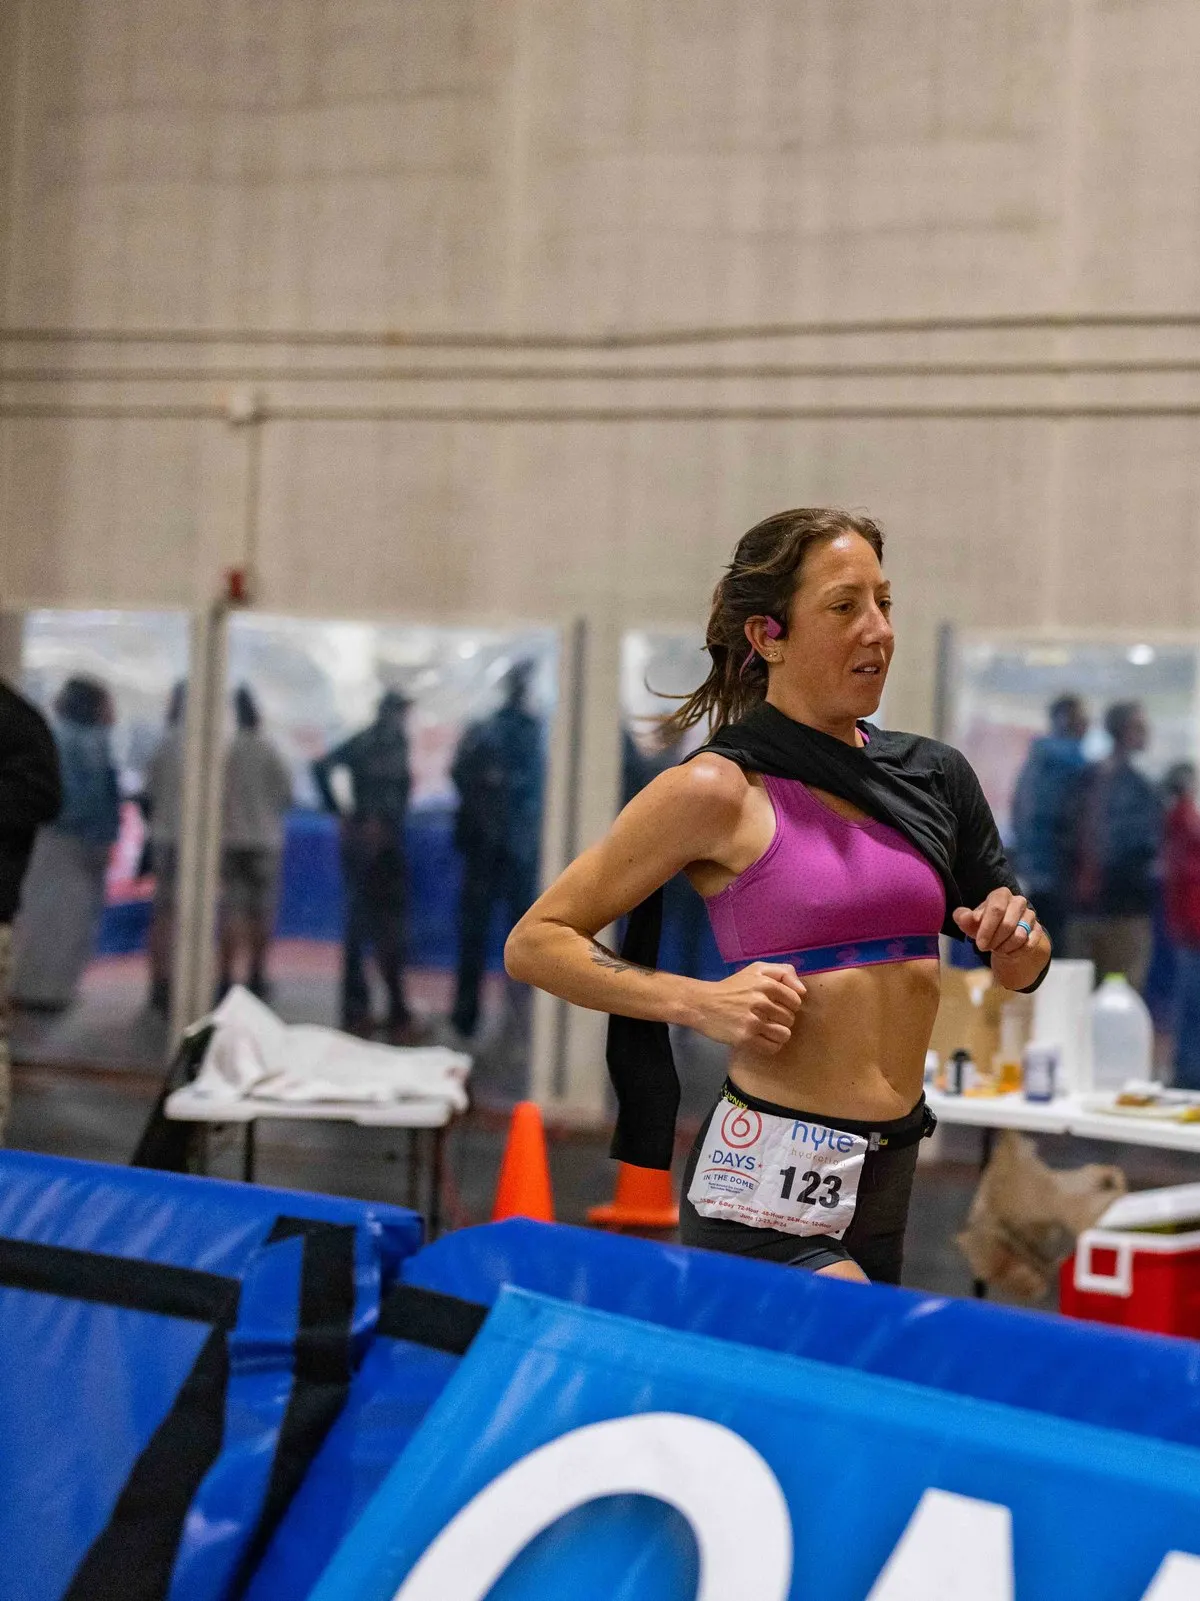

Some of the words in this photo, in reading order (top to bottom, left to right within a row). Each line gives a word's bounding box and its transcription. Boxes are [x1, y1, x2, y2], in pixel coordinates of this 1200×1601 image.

[712, 1150, 756, 1170] DAYS
[730, 1176, 754, 1190] DOME
[779, 1166, 842, 1208] 123
